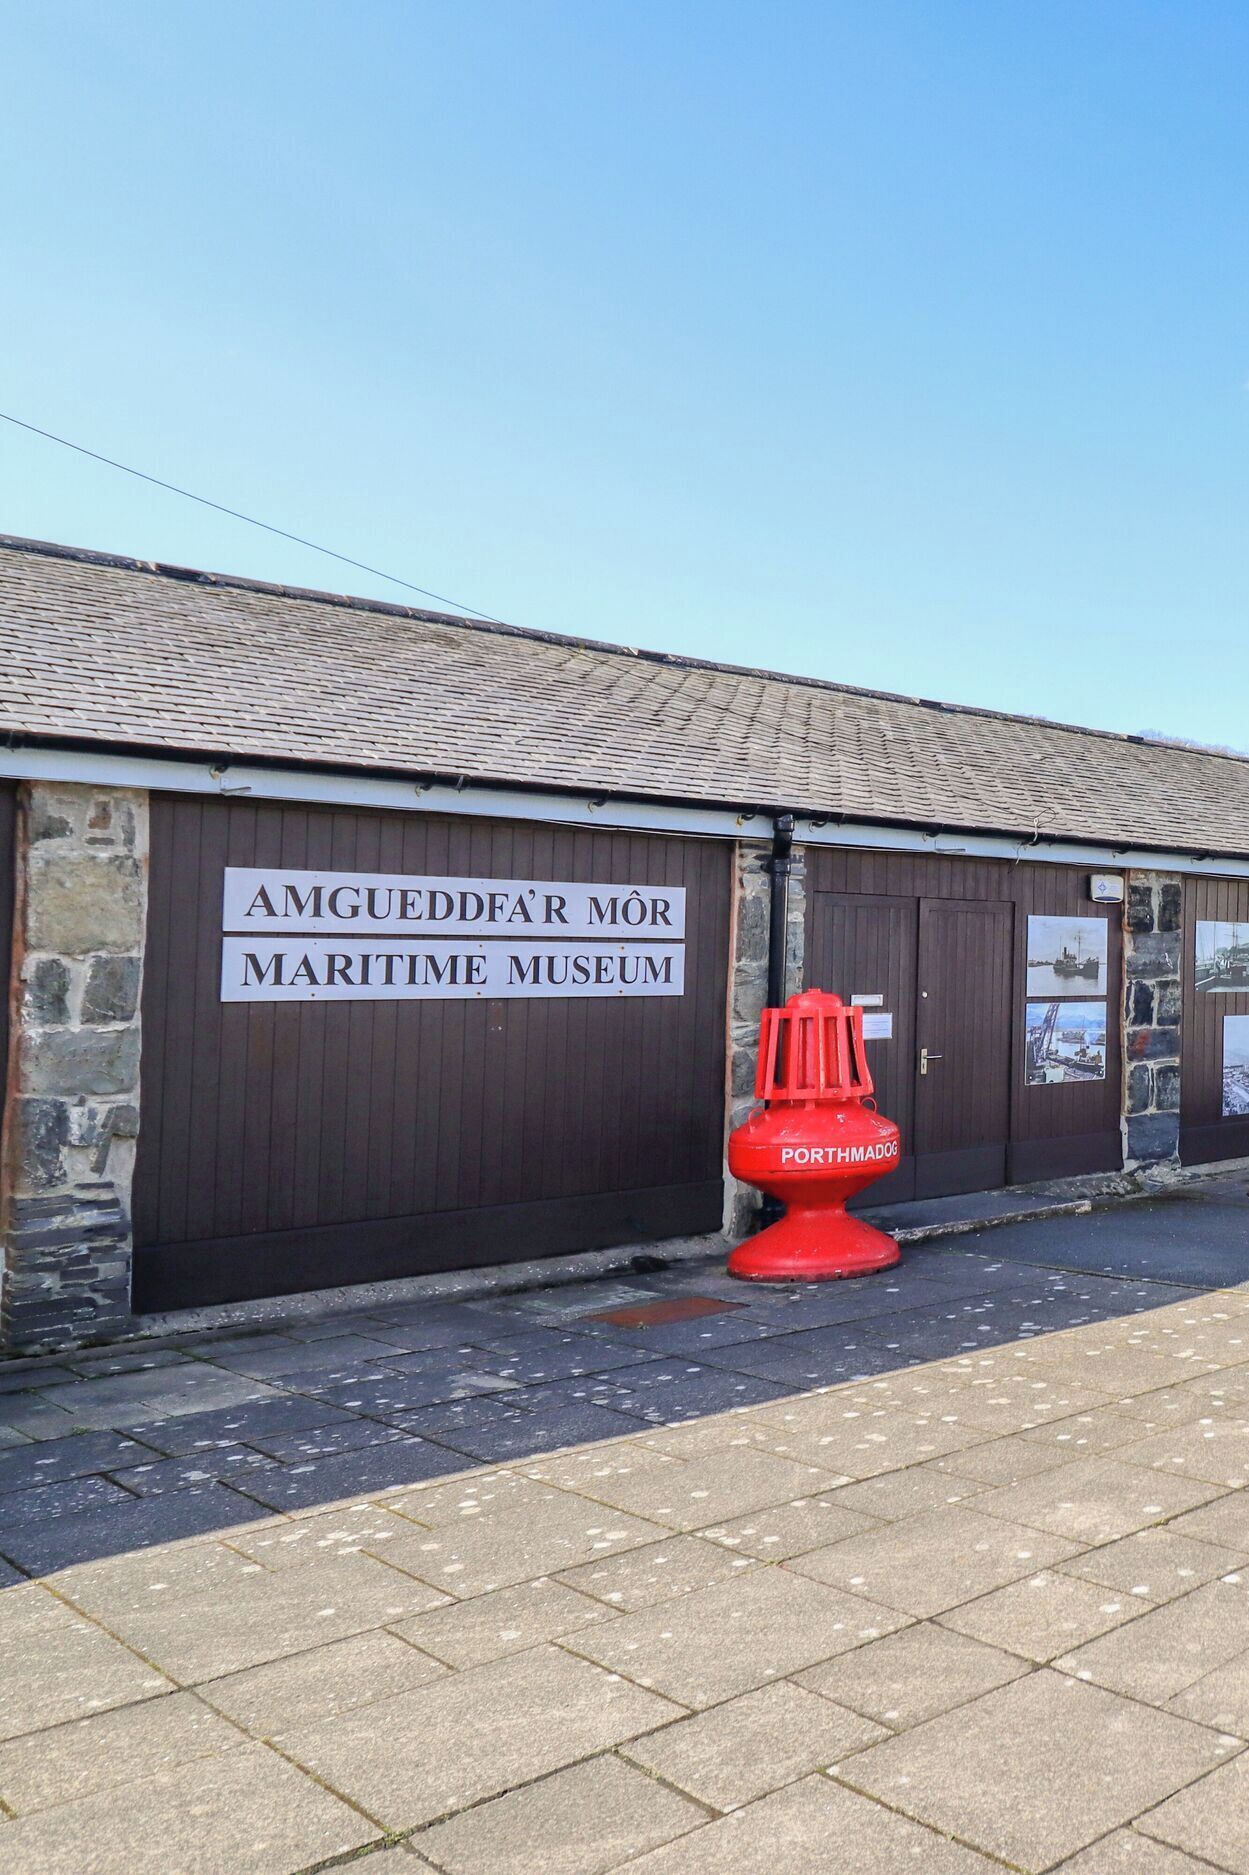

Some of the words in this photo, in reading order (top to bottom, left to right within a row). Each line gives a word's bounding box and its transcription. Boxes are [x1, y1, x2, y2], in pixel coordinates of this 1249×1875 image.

[243, 883, 569, 924] AMGUEDDFA'R
[587, 889, 673, 926] MÔR
[240, 952, 488, 986] MARITIME
[506, 955, 674, 985] MUSEUM
[781, 1140, 898, 1164] PORTHMADOG
